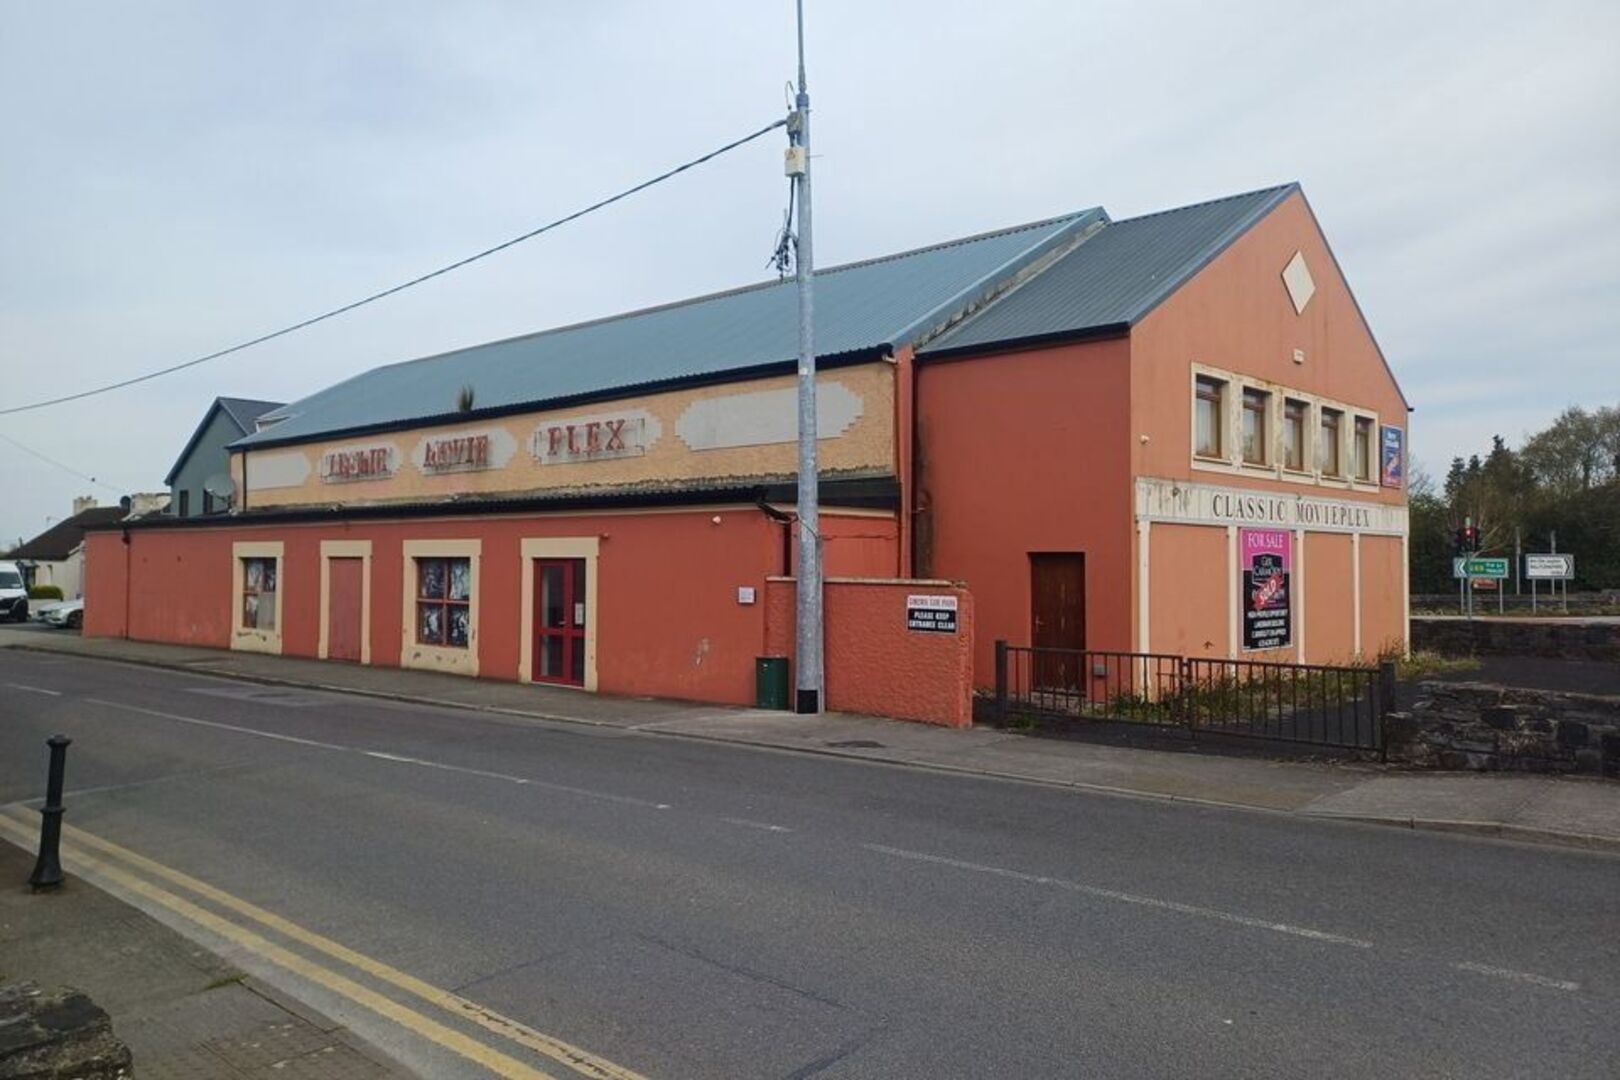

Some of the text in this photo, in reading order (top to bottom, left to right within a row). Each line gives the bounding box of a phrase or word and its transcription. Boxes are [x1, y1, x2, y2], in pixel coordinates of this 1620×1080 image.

[547, 419, 626, 456] PLEX
[1212, 494, 1285, 521] CLASSIC
[1295, 502, 1370, 527] MOVIEPLEX
[1248, 533, 1283, 549] FOR SALE
[914, 611, 934, 620] PLEASE
